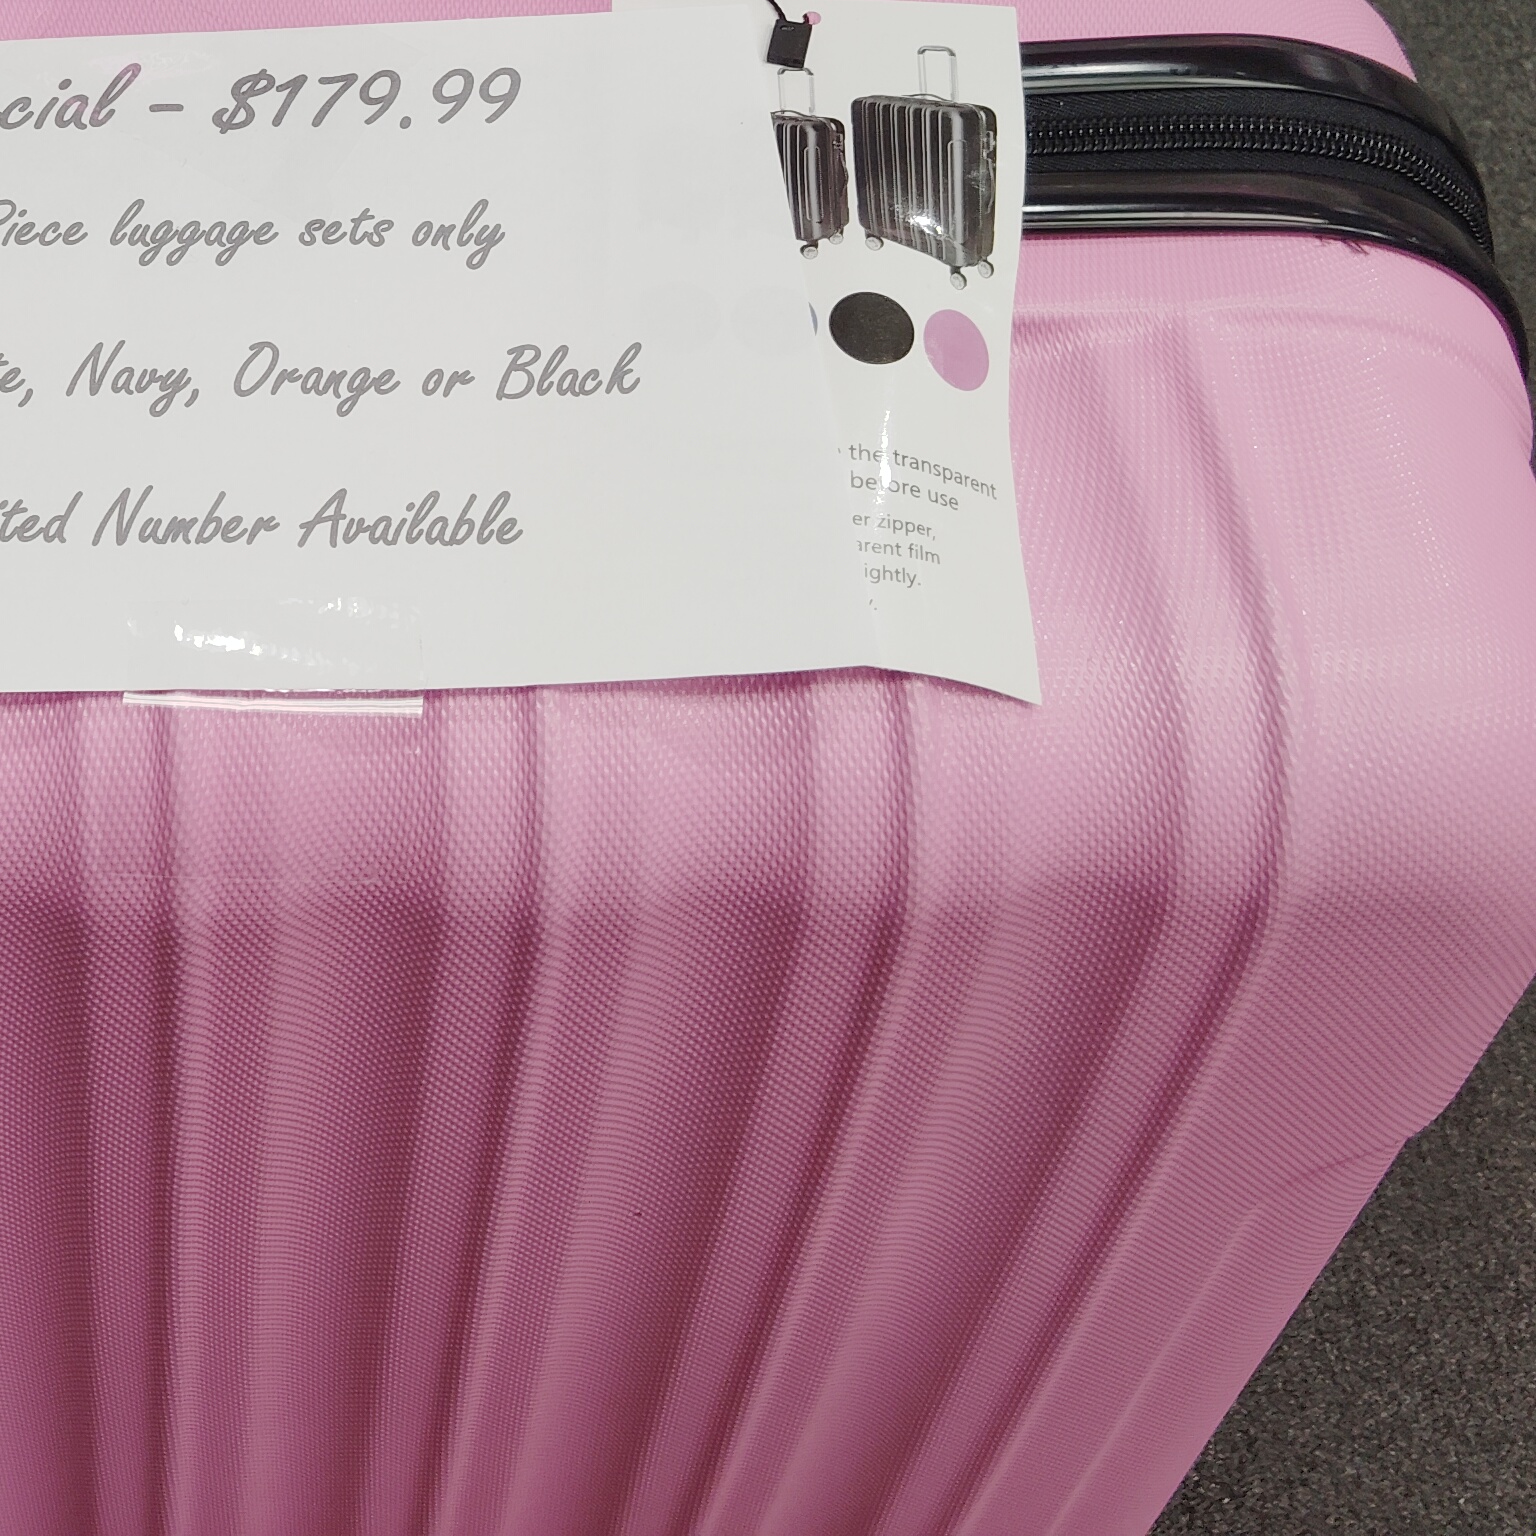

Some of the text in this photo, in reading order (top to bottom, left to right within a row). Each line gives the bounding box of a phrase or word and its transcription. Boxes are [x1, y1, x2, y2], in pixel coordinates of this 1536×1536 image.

[211, 67, 523, 134] $179.99
[108, 198, 279, 267] luggage
[298, 206, 393, 249] sets
[411, 198, 506, 270] only
[64, 340, 201, 418] Navy,
[232, 341, 400, 417] Orange
[420, 369, 476, 398] or
[495, 341, 642, 402] Black
[848, 443, 998, 501] the transparent
[850, 469, 959, 511] beore use
[91, 485, 281, 547] Number
[296, 488, 524, 548] Available
[876, 513, 937, 542] zipper,
[864, 562, 922, 589] ightly.
[908, 543, 941, 565] film
